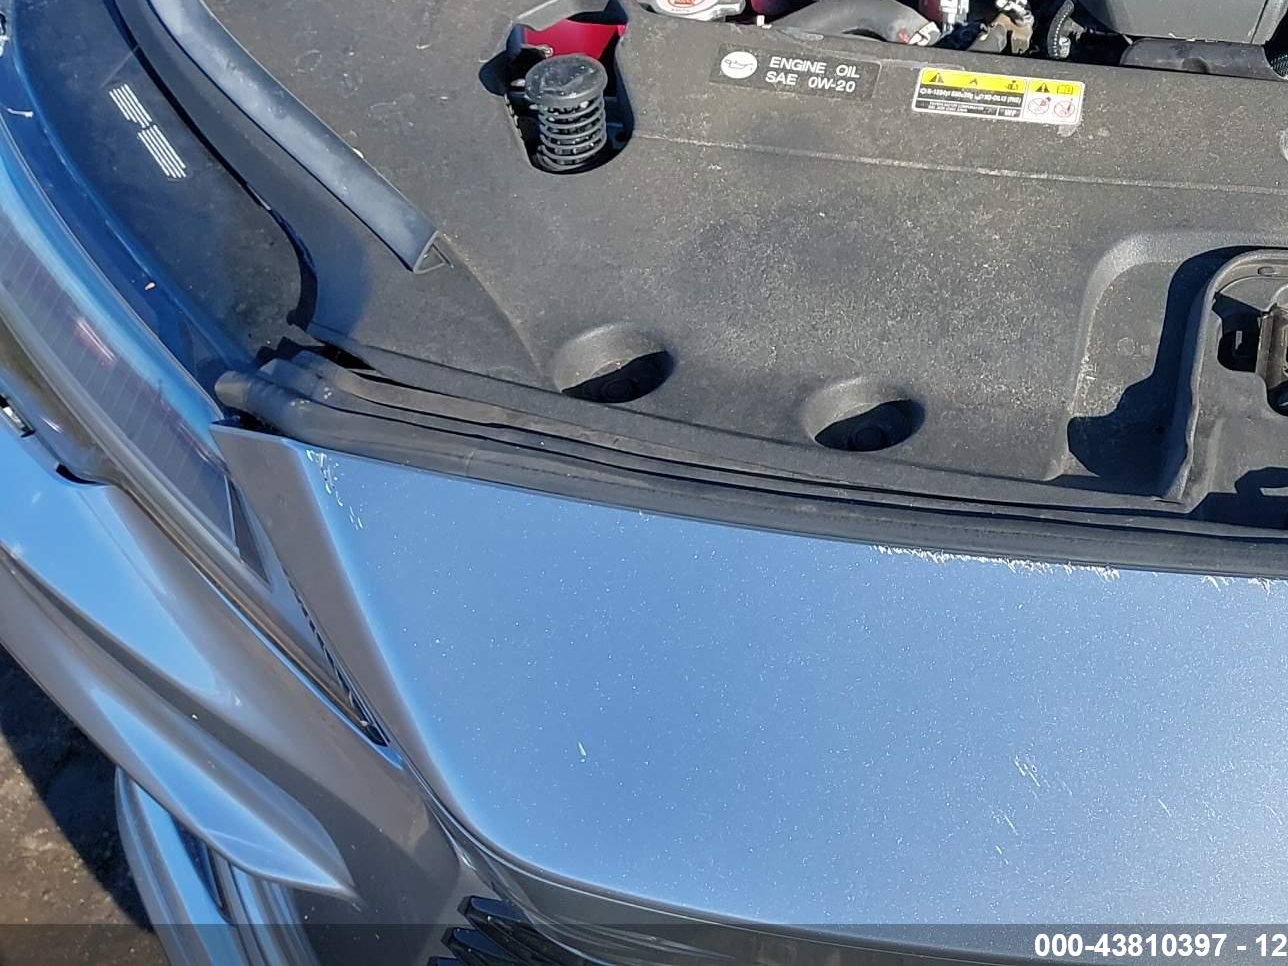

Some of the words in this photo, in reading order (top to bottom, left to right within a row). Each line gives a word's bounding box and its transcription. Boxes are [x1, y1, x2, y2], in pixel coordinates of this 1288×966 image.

[769, 56, 827, 74] ENGINE
[835, 65, 860, 78] OIL
[765, 71, 799, 86] SAE
[808, 76, 856, 93] 0W-20
